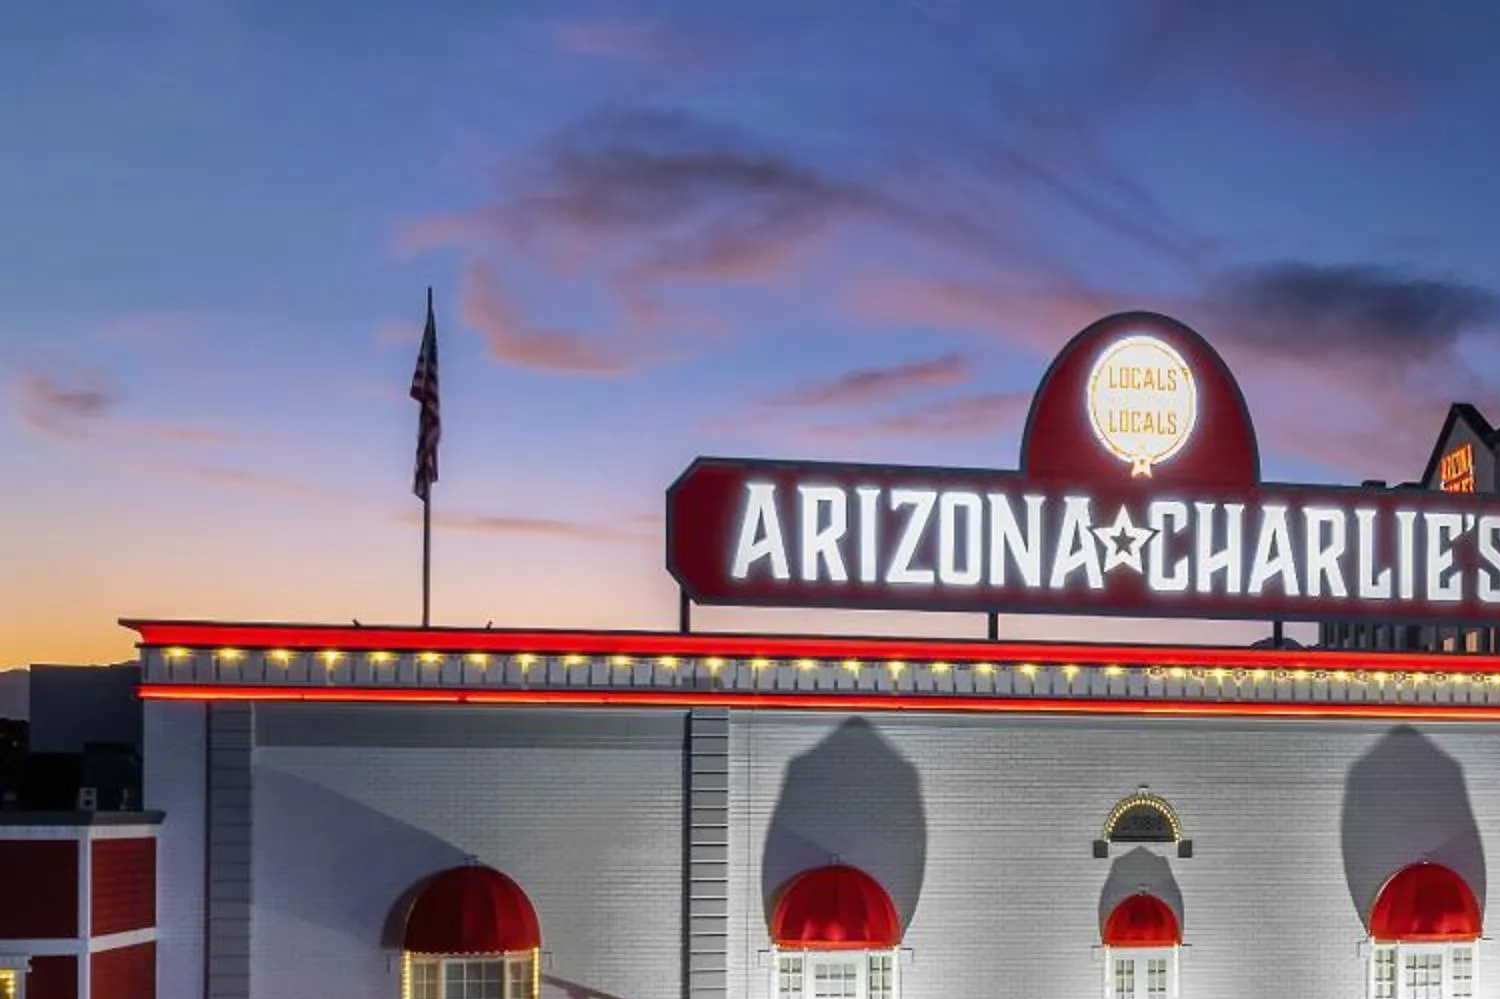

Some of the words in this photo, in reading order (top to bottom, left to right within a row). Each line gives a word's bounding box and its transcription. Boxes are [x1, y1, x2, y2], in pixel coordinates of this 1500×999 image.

[1108, 365, 1177, 391] LOCALS
[1108, 409, 1177, 435] LOCALS
[731, 482, 1104, 589] ARIZONA
